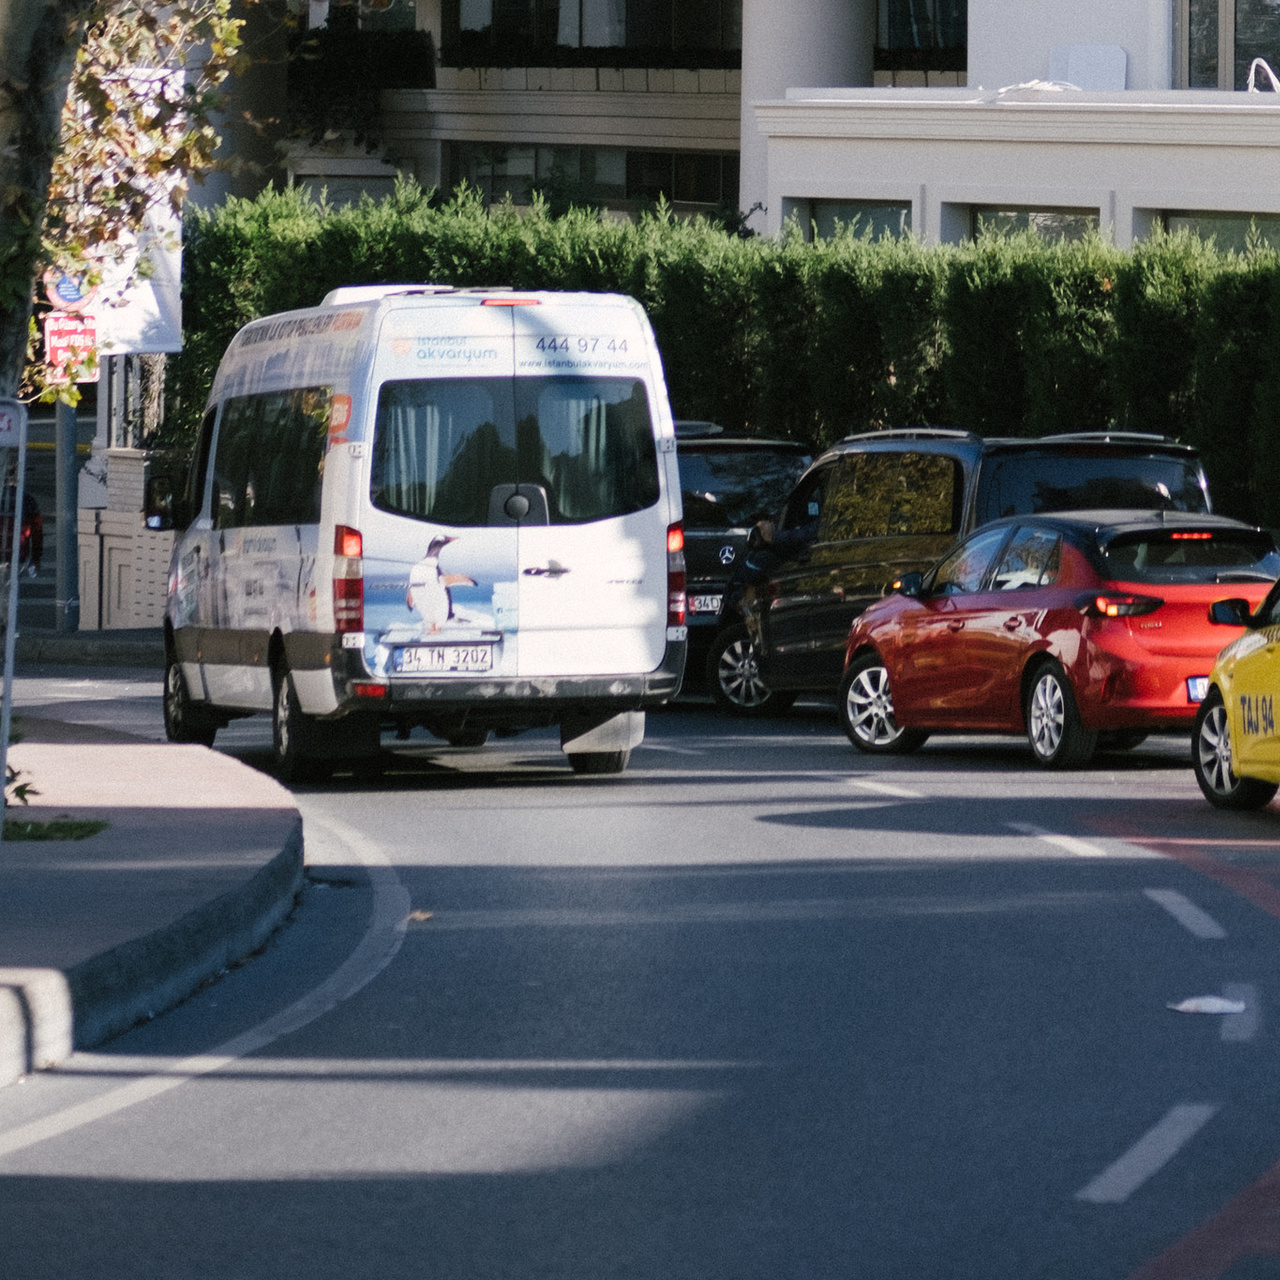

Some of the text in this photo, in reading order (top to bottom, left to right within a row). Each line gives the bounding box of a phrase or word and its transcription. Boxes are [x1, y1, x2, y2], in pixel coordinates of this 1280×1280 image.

[536, 337, 629, 353] 444 97 44
[416, 347, 497, 362] akvaryum
[404, 648, 488, 665] 34 TN 3202
[1240, 694, 1275, 737] TAJ 94
